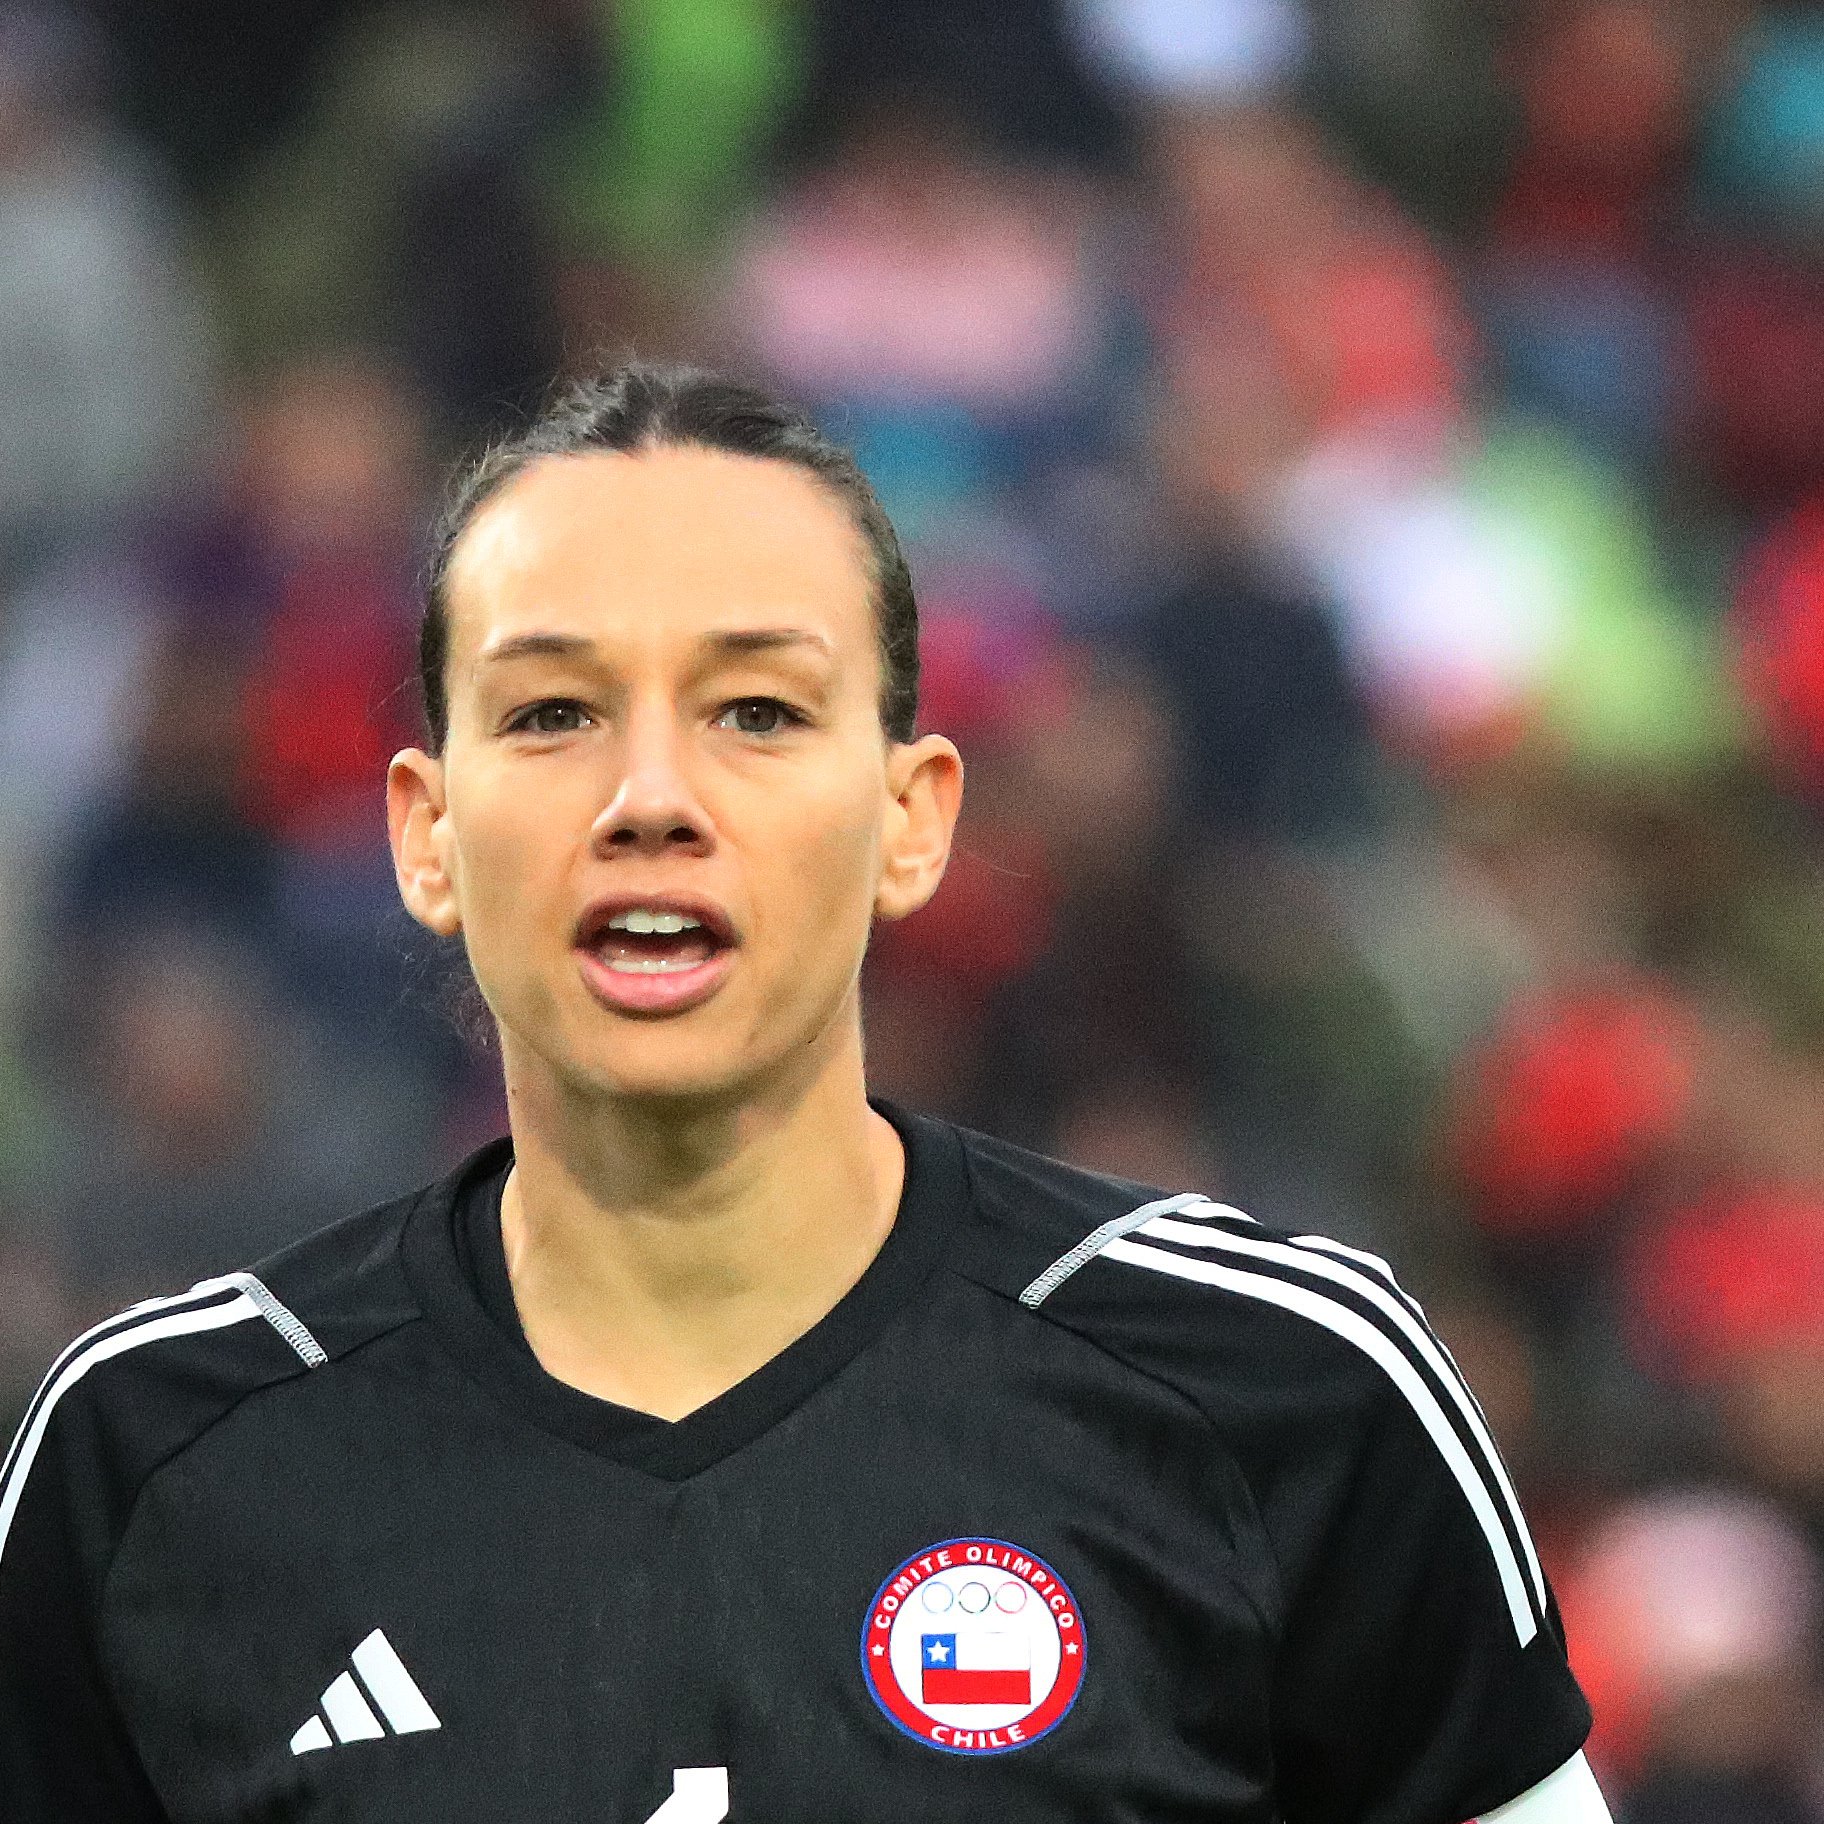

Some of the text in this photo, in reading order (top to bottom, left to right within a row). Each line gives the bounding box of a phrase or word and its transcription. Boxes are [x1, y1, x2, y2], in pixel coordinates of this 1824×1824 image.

[875, 1546, 1075, 1629] COMITE OLIMPICO
[931, 1724, 1026, 1748] CHILE
